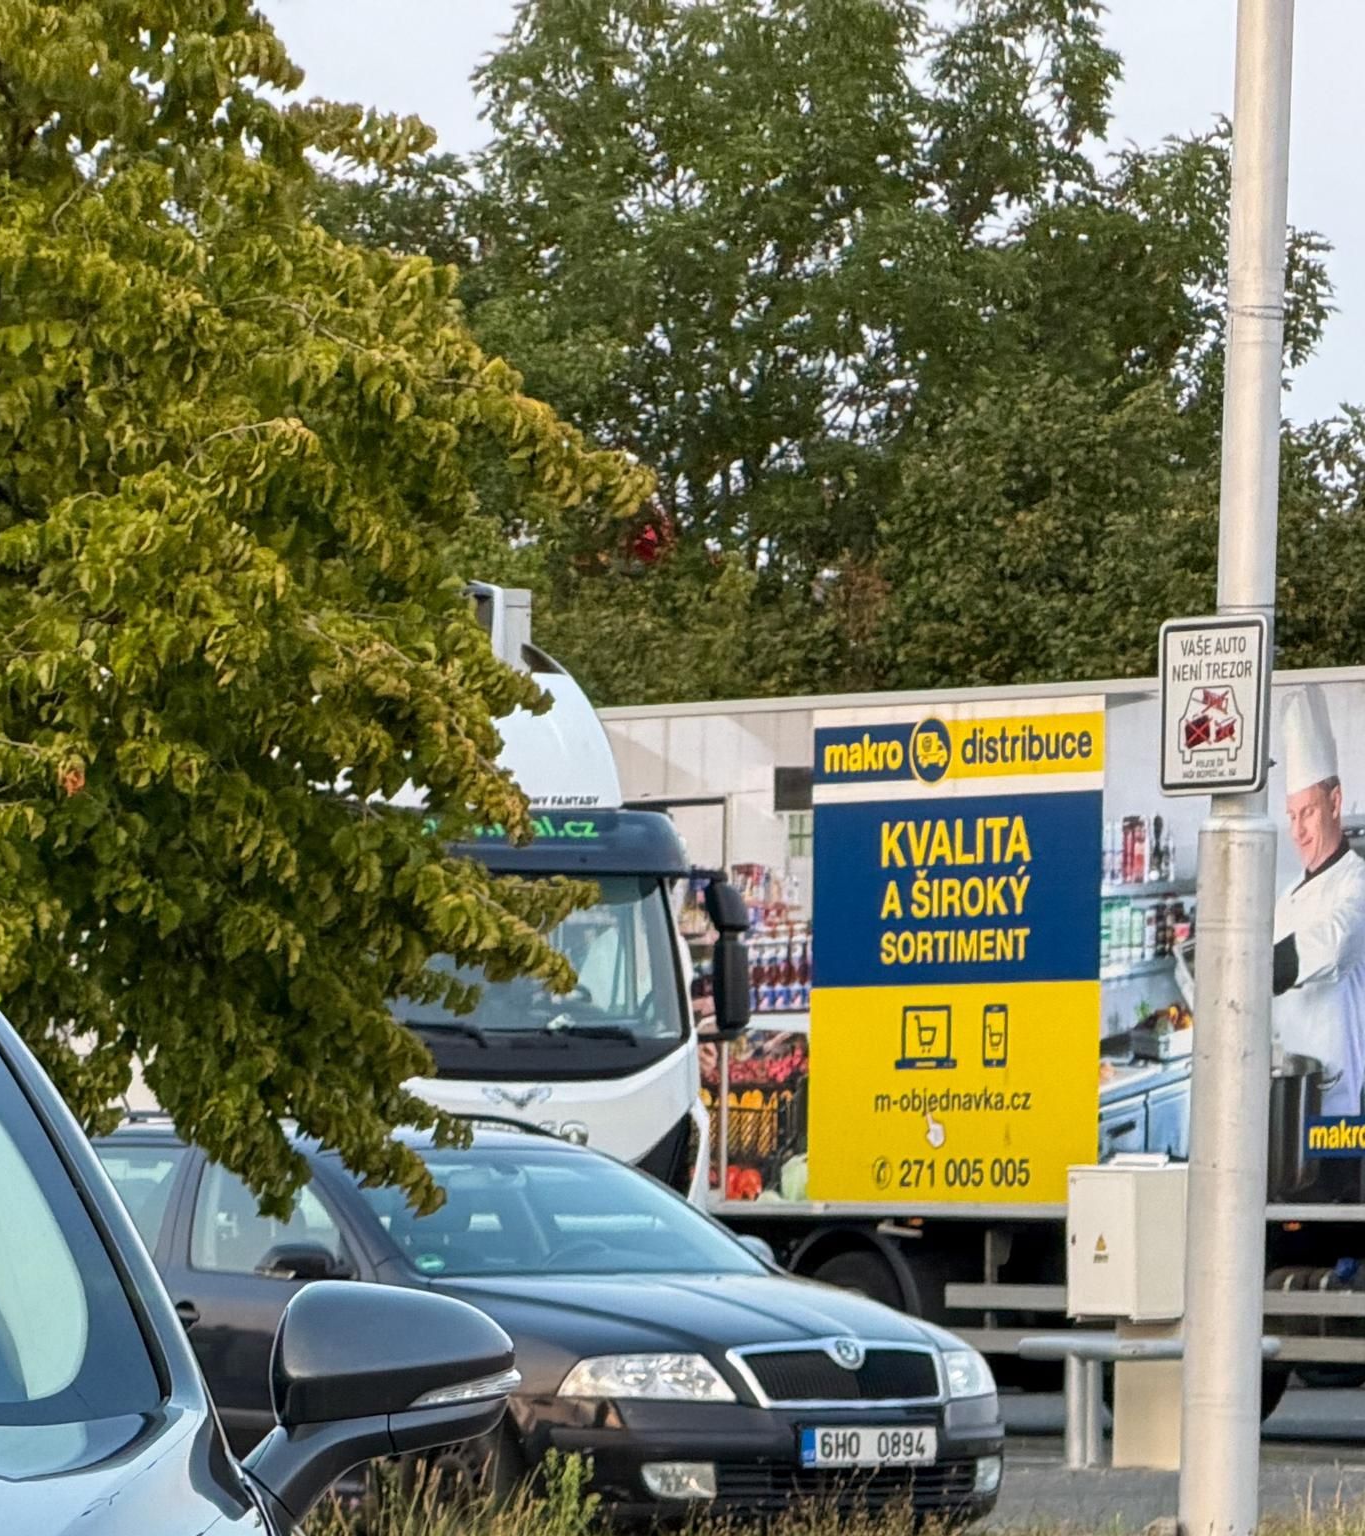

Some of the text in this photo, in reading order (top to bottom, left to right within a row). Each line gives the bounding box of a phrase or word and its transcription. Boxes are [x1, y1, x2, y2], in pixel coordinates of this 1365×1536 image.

[1181, 635, 1246, 656] VAŠE AUTO
[1172, 659, 1253, 682] NENÍ TREZOR
[824, 724, 1092, 773] makro distribuce
[881, 815, 1032, 868] KVALITA
[880, 866, 1030, 920] A ŠIROKÝ
[880, 927, 1031, 964] SORTIMENT
[874, 1086, 1031, 1117] m-objednavka.cz
[899, 1158, 1030, 1187] 271 005 005
[820, 1431, 860, 1458] 6H0
[877, 1431, 925, 1458] 0894
